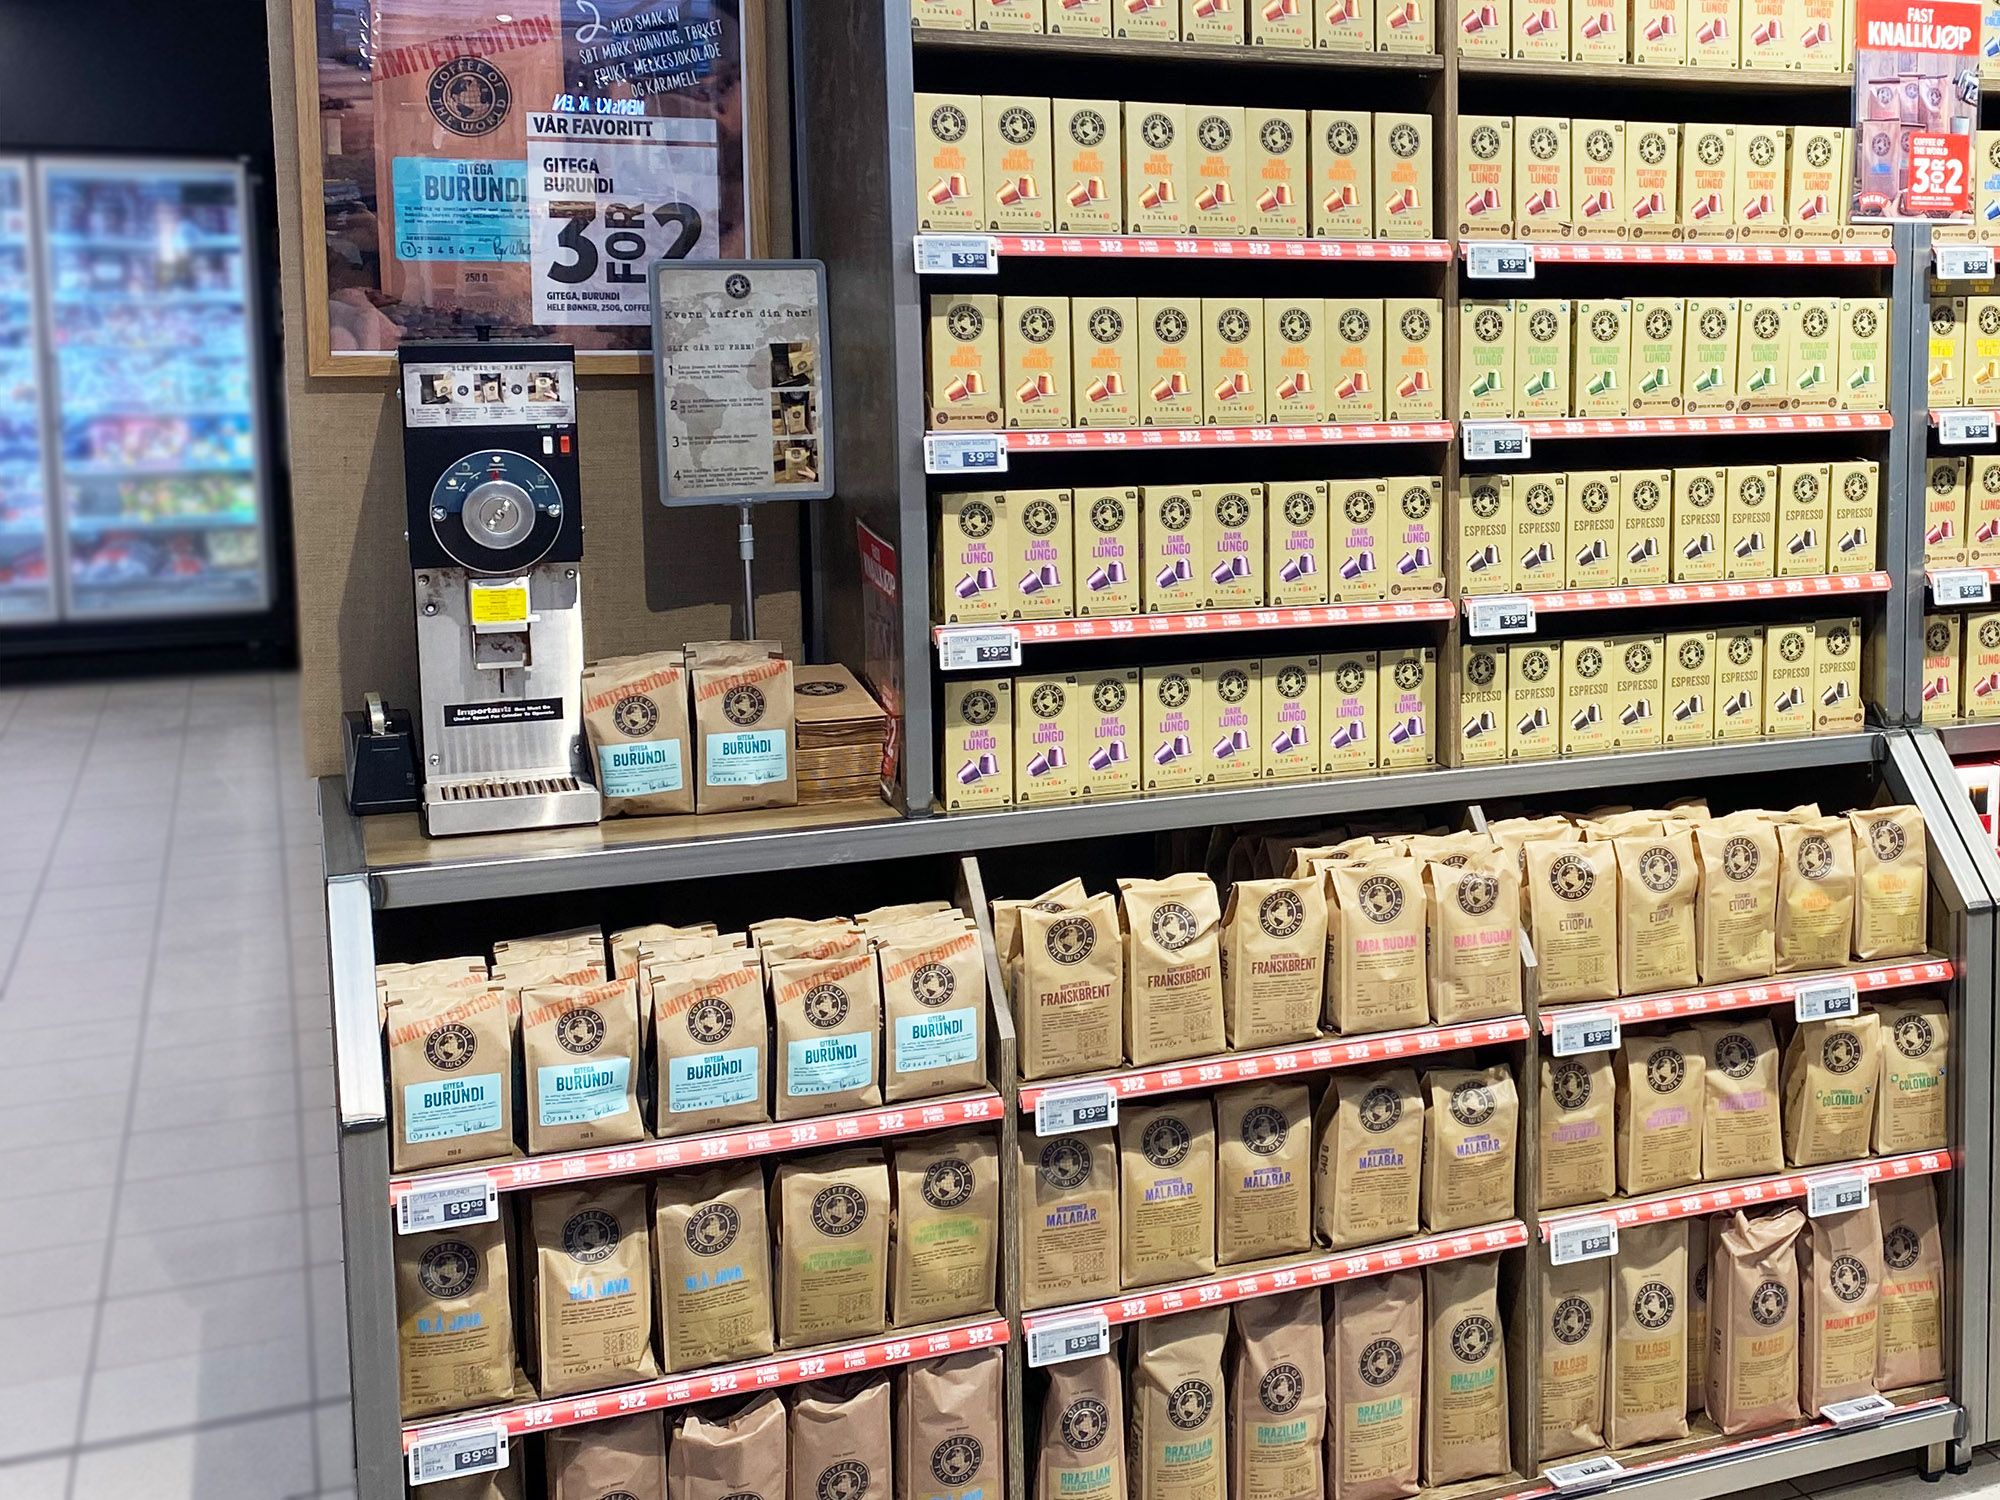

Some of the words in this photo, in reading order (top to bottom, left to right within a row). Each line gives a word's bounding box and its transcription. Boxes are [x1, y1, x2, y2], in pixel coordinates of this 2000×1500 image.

[611, 18, 634, 34] MED
[636, 13, 665, 30] SMAK
[668, 6, 680, 22] AV
[1908, 8, 1934, 23] FAST
[580, 47, 600, 65] SØT
[602, 41, 632, 59] MØRK
[633, 30, 684, 53] HONNING,
[685, 19, 724, 41] TØRKET
[1868, 21, 1971, 50] KNALLKJØP
[594, 62, 633, 80] FRUKT,
[634, 46, 722, 75] MELKESJOKOLADE
[434, 60, 484, 90] COFFEE
[488, 72, 505, 89] OF
[631, 83, 645, 98] OG
[645, 74, 700, 95] KARAMELL
[432, 99, 456, 126] THE
[460, 99, 507, 132] WORLD
[534, 113, 568, 133] VÅR
[573, 119, 653, 137] FAVORITT
[458, 163, 493, 175] GITEGA
[544, 158, 599, 173] GITEGA
[1472, 173, 1499, 184] LUNGO
[1914, 158, 1930, 194] 3
[1930, 159, 1946, 194] FOR
[1946, 159, 1963, 194] 2
[544, 177, 613, 193] BURUNDI
[547, 200, 598, 284] 3
[605, 202, 646, 283] FOR
[652, 202, 702, 259] 2
[547, 292, 580, 301] GITEGA,
[582, 292, 620, 300] BURUNDI
[547, 304, 565, 312] HELE
[567, 304, 600, 313] BØNNER,
[601, 304, 623, 312] 250G,
[665, 310, 703, 319] Kvern
[710, 309, 753, 318] kaffen
[760, 309, 780, 317] din
[787, 308, 812, 317] her!
[669, 365, 673, 376] 1
[670, 401, 677, 410] 2
[672, 437, 679, 448] 3
[673, 471, 681, 481] 4
[1837, 507, 1873, 519] ESPRESSO
[1930, 500, 1956, 513] LUNGO
[1786, 509, 1823, 520] ESPRESSO
[1408, 524, 1424, 532] DARK
[1465, 524, 1506, 536] ESPRESSO
[1574, 519, 1614, 531] ESPRESSO
[1626, 517, 1665, 529] ESPRESSO
[1099, 537, 1117, 546] DARK
[1224, 532, 1242, 540] DARK
[1402, 531, 1430, 544] LUNGO
[968, 543, 986, 551] DARK
[1092, 545, 1124, 558] LUNGO
[1217, 540, 1248, 552] LUNGO
[961, 551, 993, 565] LUNGO
[1820, 661, 1855, 673] ESPRESSO
[1722, 671, 1758, 683] ESPRESSO
[1569, 683, 1608, 696] ESPRESSO
[1617, 679, 1658, 692] ESPRESSO
[1515, 687, 1554, 700] ESPRESSO
[1166, 712, 1183, 721] DARK
[1160, 720, 1189, 733] LUNGO
[970, 730, 989, 739] DARK
[722, 739, 771, 756] BURUNDI
[963, 738, 996, 751] LUNGO
[613, 750, 666, 767] BURUNDI
[1729, 898, 1758, 912] ETIOPIA
[1559, 918, 1593, 932] ETIOPIA
[1251, 957, 1316, 975] FRANSKBRENT
[1147, 966, 1212, 989] FRANSKBRENT
[1040, 984, 1111, 1007] FRANSKBRENT
[912, 1018, 963, 1040] BURUNDI
[805, 1044, 857, 1065] BURUNDI
[686, 1059, 742, 1081] BURUNDI
[556, 1070, 614, 1092] BURUNDI
[1899, 1076, 1939, 1090] COLOMBIA
[424, 1086, 484, 1108] BURUNDI
[1823, 1094, 1863, 1107] COLOMBIA
[1456, 1139, 1500, 1157] MALABAR
[1359, 1153, 1404, 1169] MALABAR
[1145, 1182, 1194, 1201] MALABAR
[1046, 1208, 1098, 1228] MALABAR
[1824, 1315, 1854, 1330] MOUNT
[1635, 1341, 1670, 1357] KALOSSI
[1553, 1355, 1588, 1371] KALOSSI
[1451, 1367, 1495, 1385] BRAZILIAN
[1357, 1398, 1402, 1414] BRAZILIAN
[1258, 1423, 1307, 1440] BRAZILIAN
[1164, 1438, 1213, 1457] BRAZILIAN
[1060, 1466, 1111, 1485] BRAZILIAN
